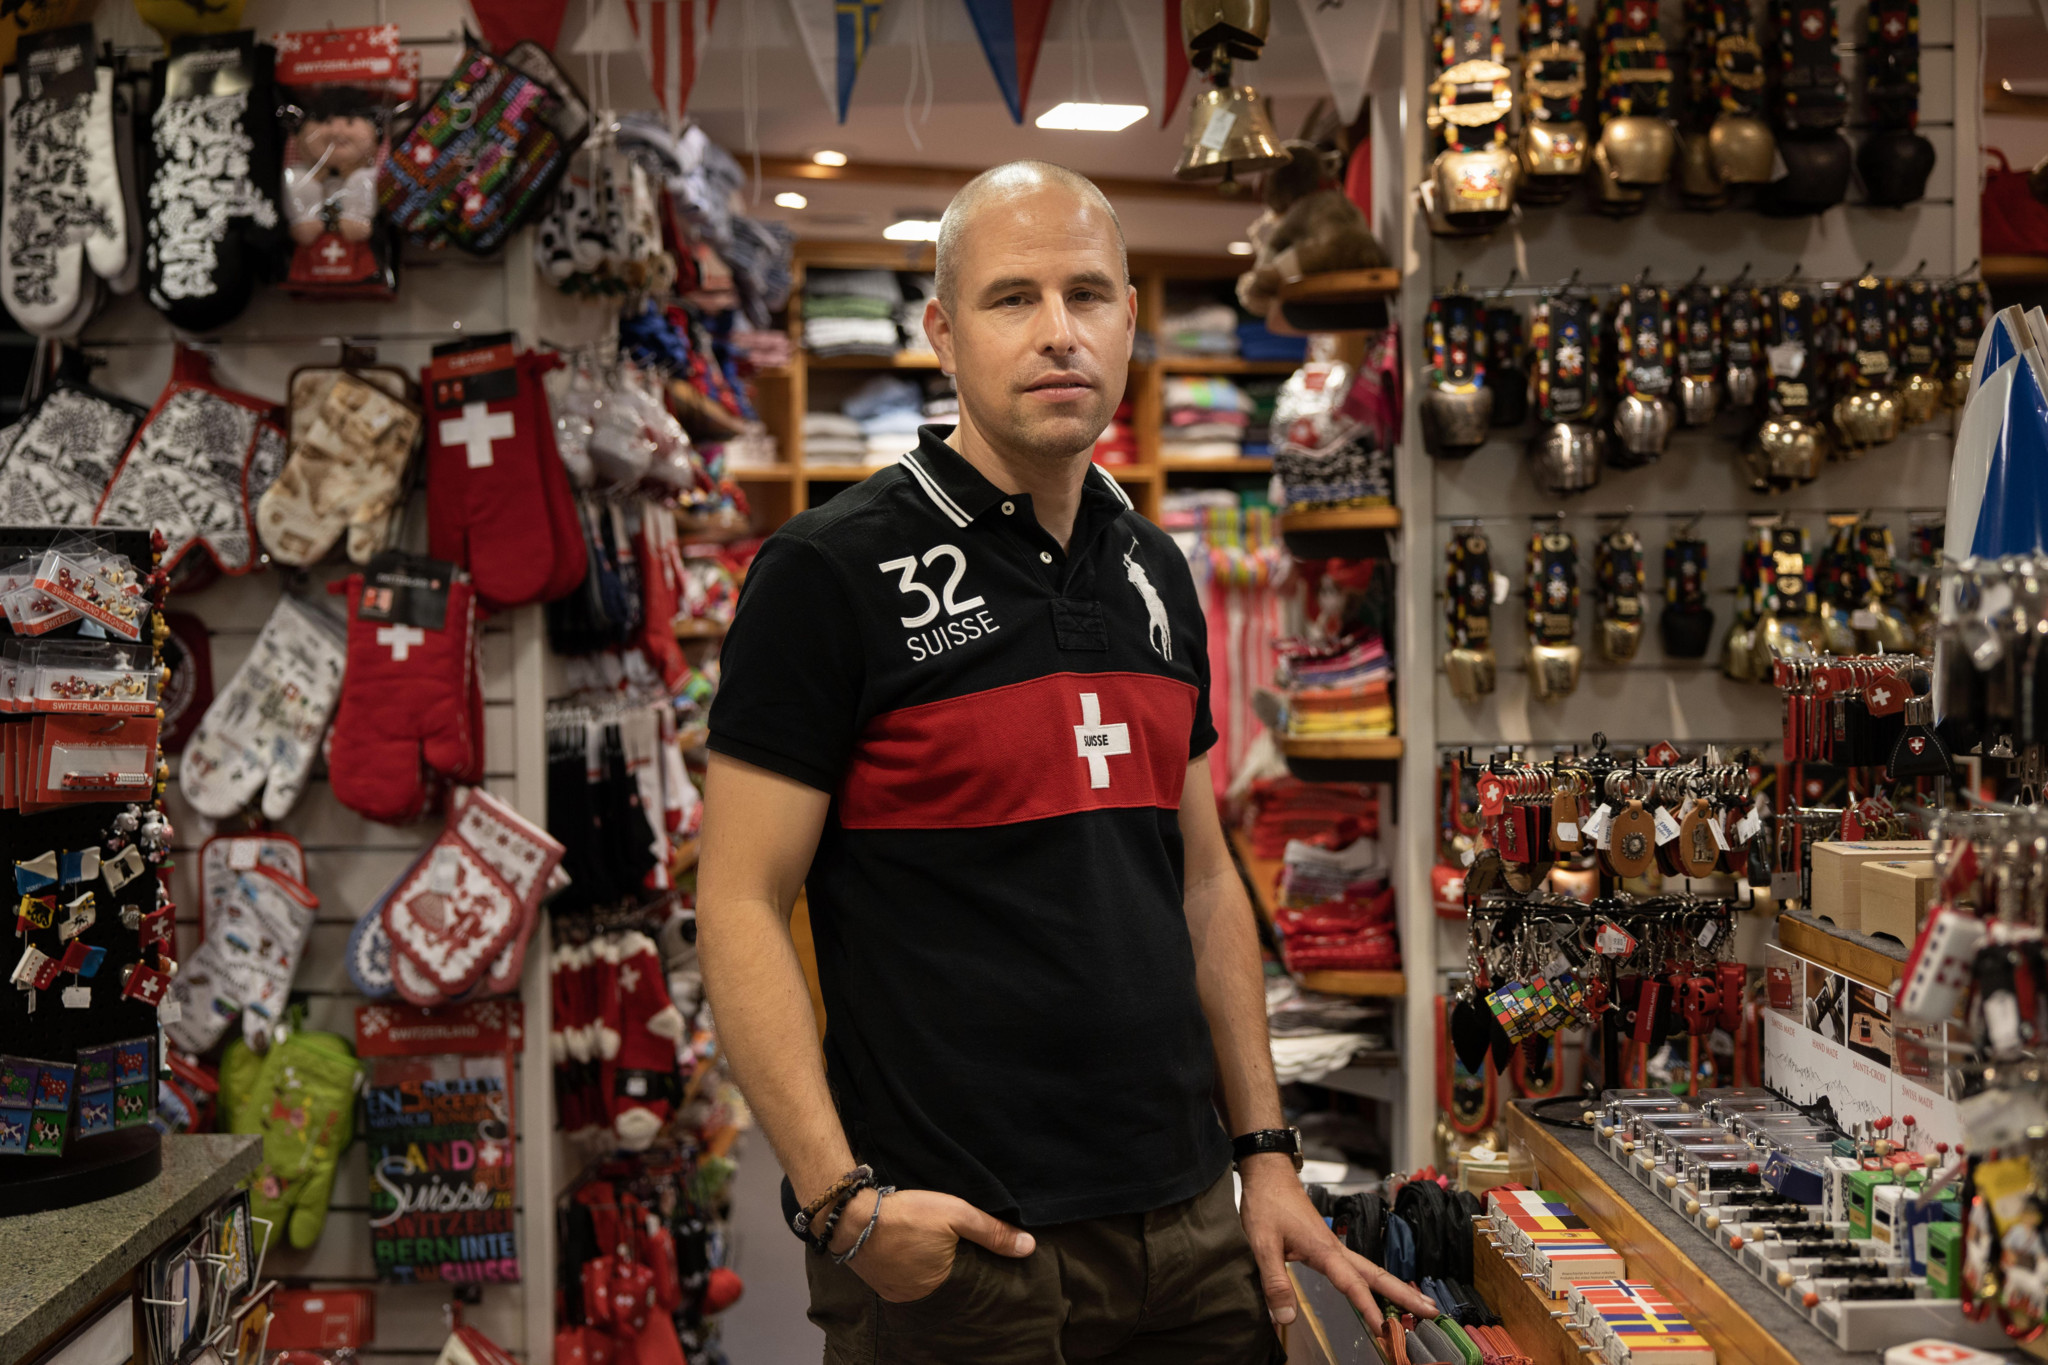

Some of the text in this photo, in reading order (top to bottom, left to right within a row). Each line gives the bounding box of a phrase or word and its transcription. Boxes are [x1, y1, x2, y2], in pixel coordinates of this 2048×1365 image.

[878, 544, 986, 629] 32
[43, 609, 82, 631] SWITZER
[51, 586, 134, 635] SWITZERLAND MAGNETS
[907, 610, 1000, 662] SUISSE
[52, 702, 151, 713] SWITZERLAND MAGNETS
[1084, 734, 1109, 747] SUISSE
[1646, 992, 1657, 1031] SWITZERLAND
[1771, 1016, 1796, 1037] SWISS MADE
[1812, 1038, 1839, 1060] HAND MADE
[1852, 1059, 1887, 1084] SAINTE-CROIX
[1901, 1084, 1934, 1110] SWISS MADE
[369, 1155, 494, 1228] Suisse
